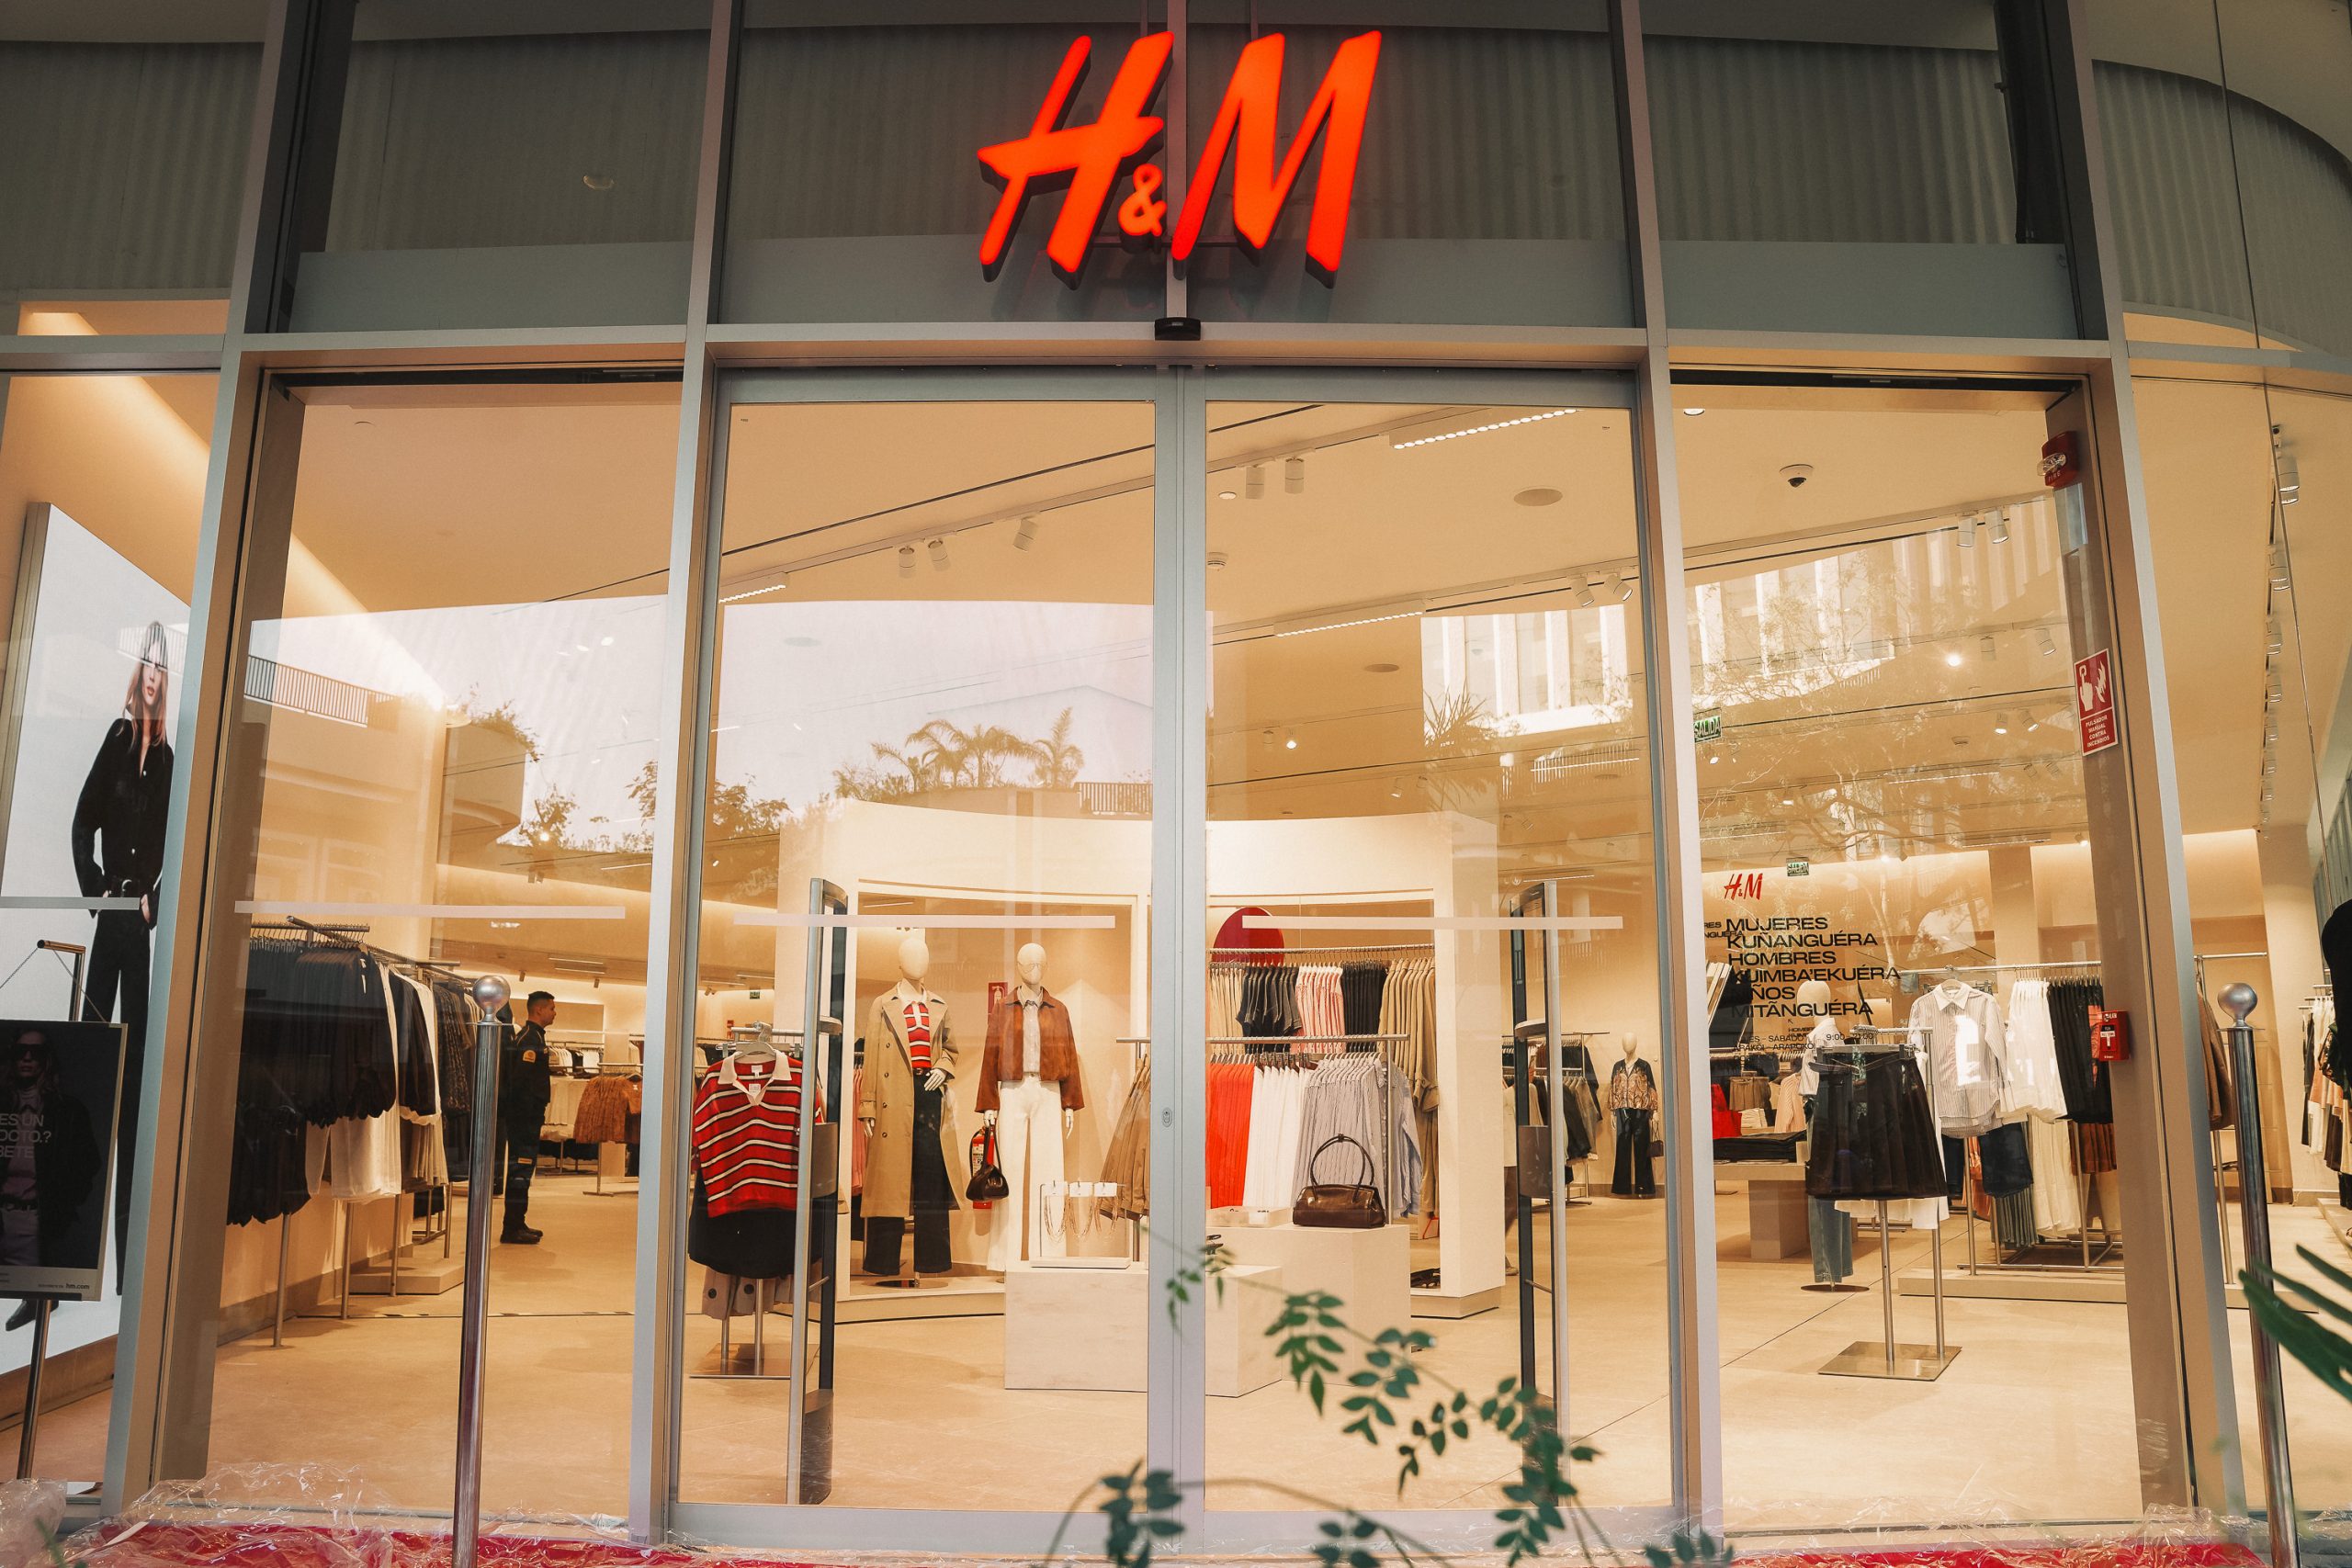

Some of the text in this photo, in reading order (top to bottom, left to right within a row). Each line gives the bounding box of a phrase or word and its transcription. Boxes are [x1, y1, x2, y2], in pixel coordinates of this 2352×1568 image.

[977, 30, 1382, 274] H&M
[1694, 716, 1721, 738] SALIDA
[2086, 715, 2108, 728] PULSADOR
[2088, 724, 2106, 733] MANUAL
[2086, 736, 2110, 748] INCENDIOS
[2089, 729, 2107, 740] CONTRA
[1724, 873, 1763, 900] H&M
[1726, 917, 1828, 931] MUJERES
[1727, 930, 1878, 949] KUÑANGUÉRA
[1728, 951, 1837, 966] HOMBRES
[0, 1112, 44, 1127] ES UN
